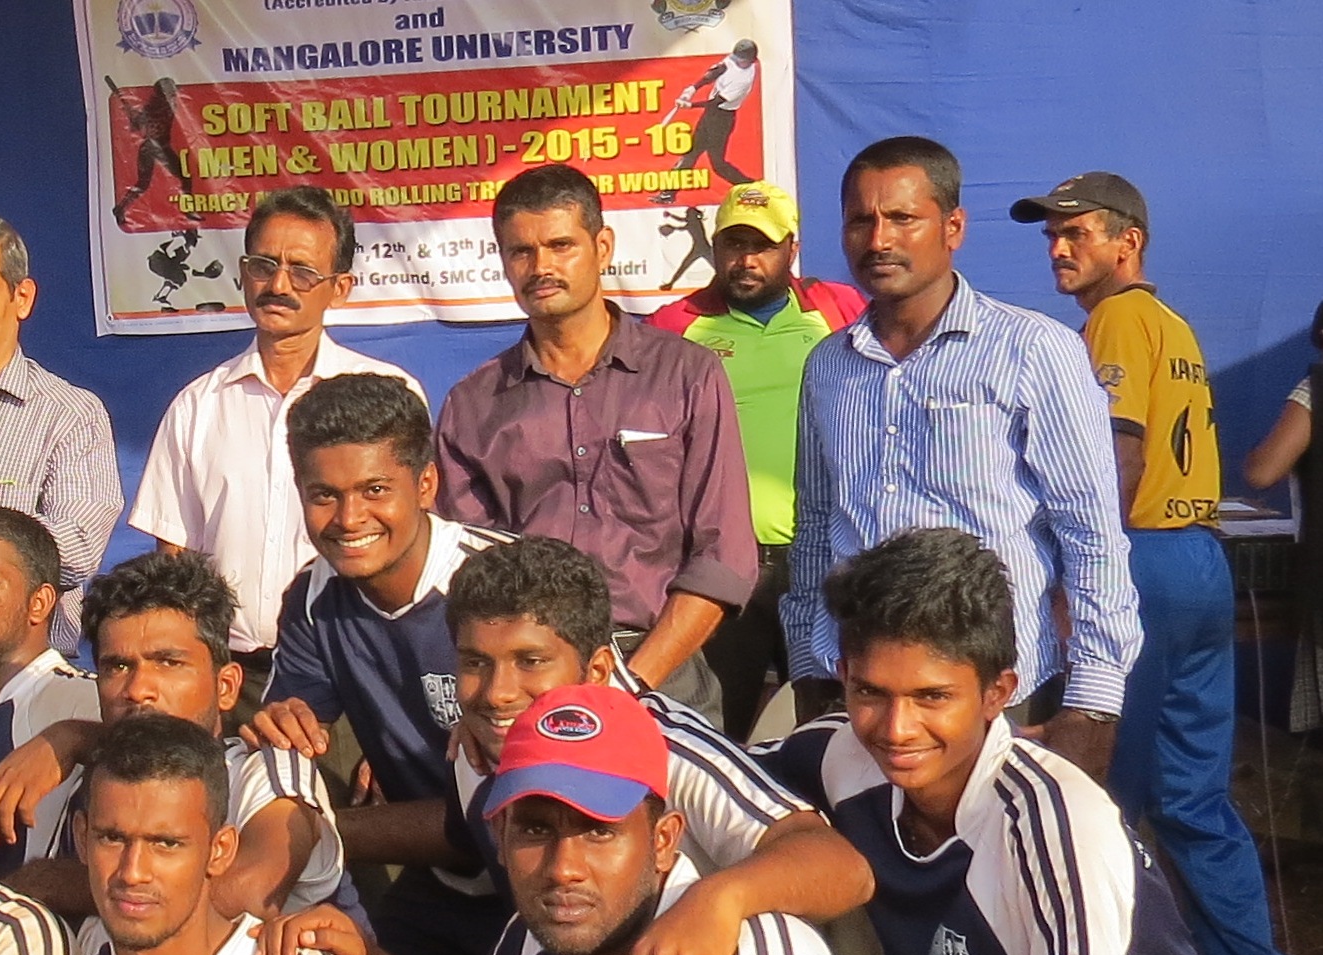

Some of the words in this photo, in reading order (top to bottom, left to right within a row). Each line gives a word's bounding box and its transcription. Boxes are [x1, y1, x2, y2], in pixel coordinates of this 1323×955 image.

[395, 7, 444, 30] and
[222, 37, 423, 73] MANGALORE
[432, 24, 634, 62] UNIVERSITY
[201, 102, 291, 136] SOFT
[302, 97, 391, 132] BALL
[399, 80, 664, 126] TOURNAMENT
[198, 145, 277, 179] MEN
[285, 145, 322, 175] &
[328, 135, 478, 174] WOMEN
[520, 126, 620, 164] 2015
[645, 121, 694, 155] 16
[369, 182, 463, 206] ROLLING
[619, 169, 710, 193] WOMEN
[417, 242, 432, 259] &
[438, 237, 474, 258] 13th
[478, 238, 498, 260] Ja
[369, 270, 435, 288] Ground,
[439, 269, 477, 285] SMC
